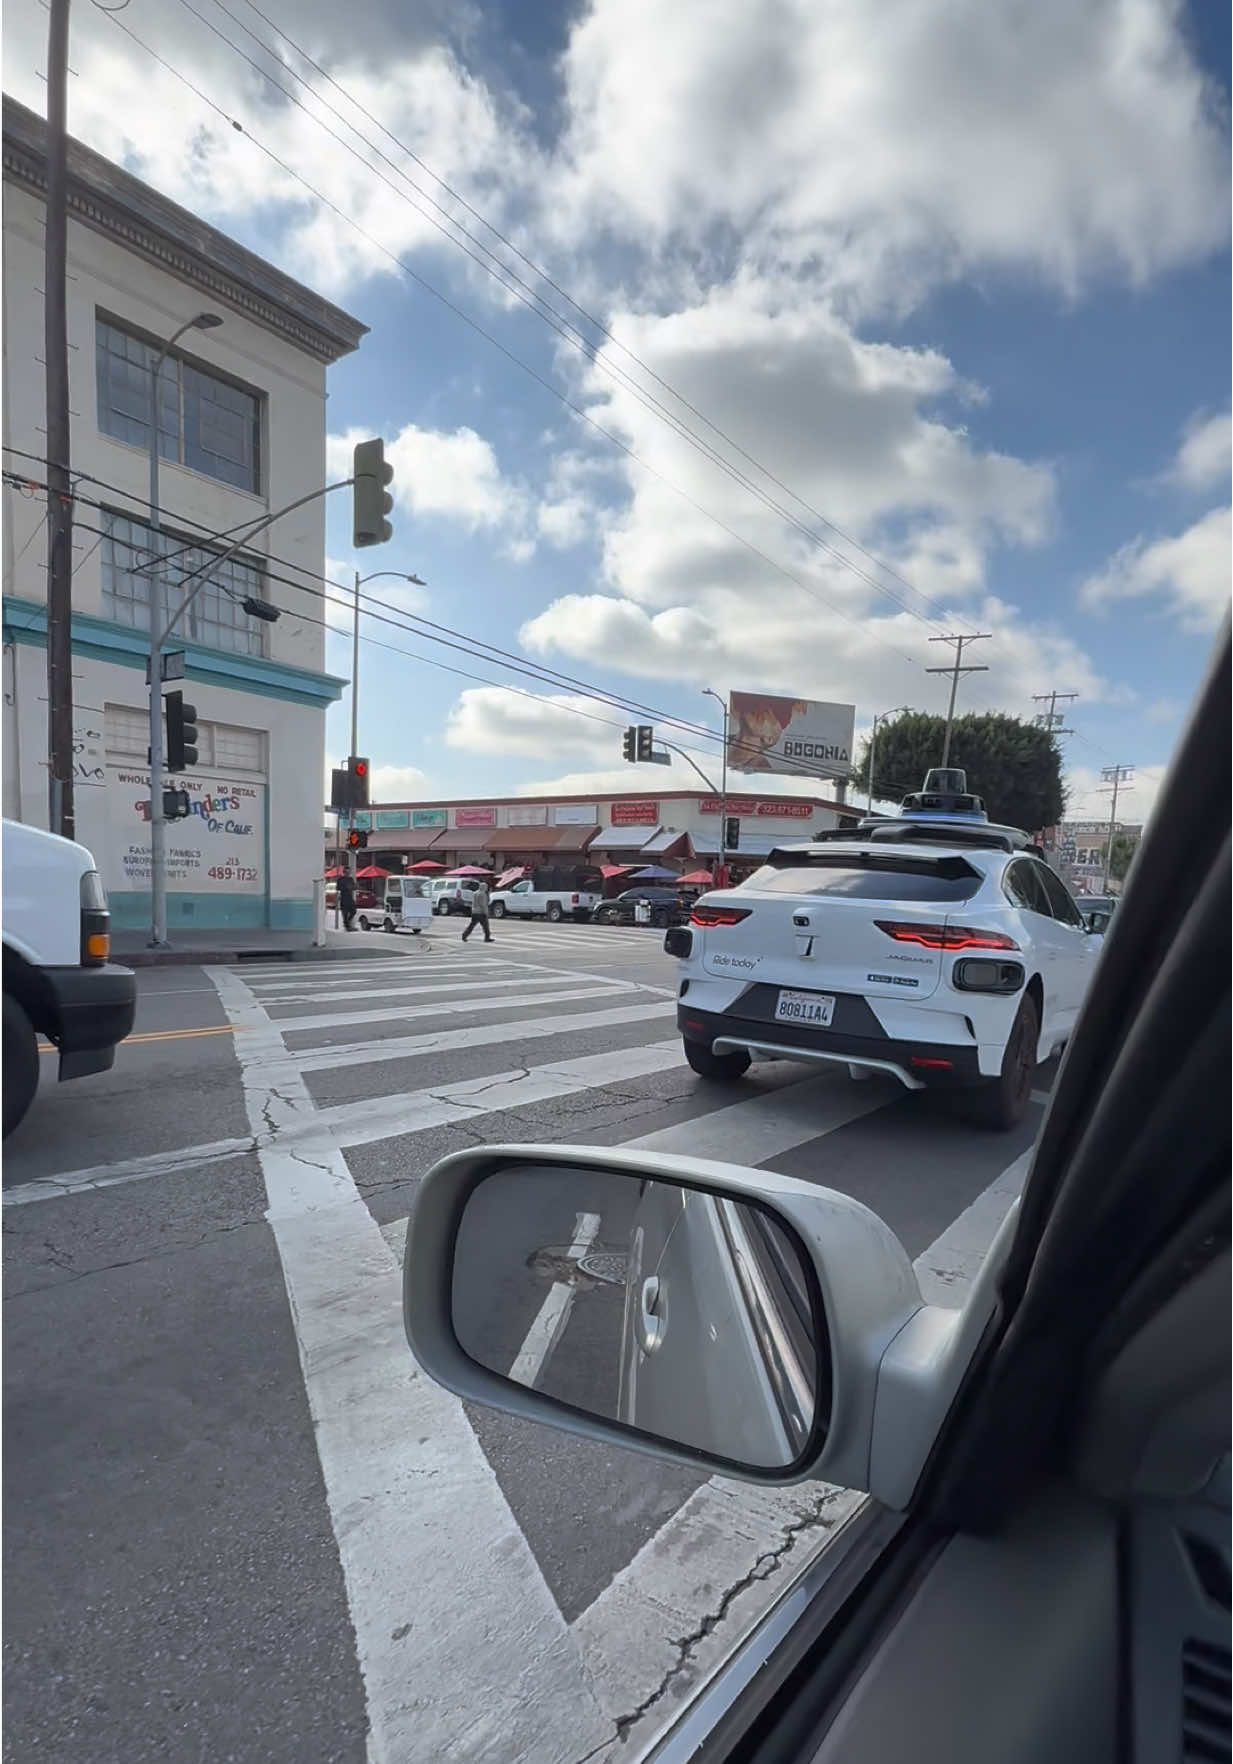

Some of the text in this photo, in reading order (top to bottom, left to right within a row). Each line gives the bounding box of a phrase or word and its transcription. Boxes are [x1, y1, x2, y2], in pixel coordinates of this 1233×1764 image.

[118, 774, 257, 798] WHOLELE ONLY NO RETAIL
[713, 955, 757, 969] Ride today
